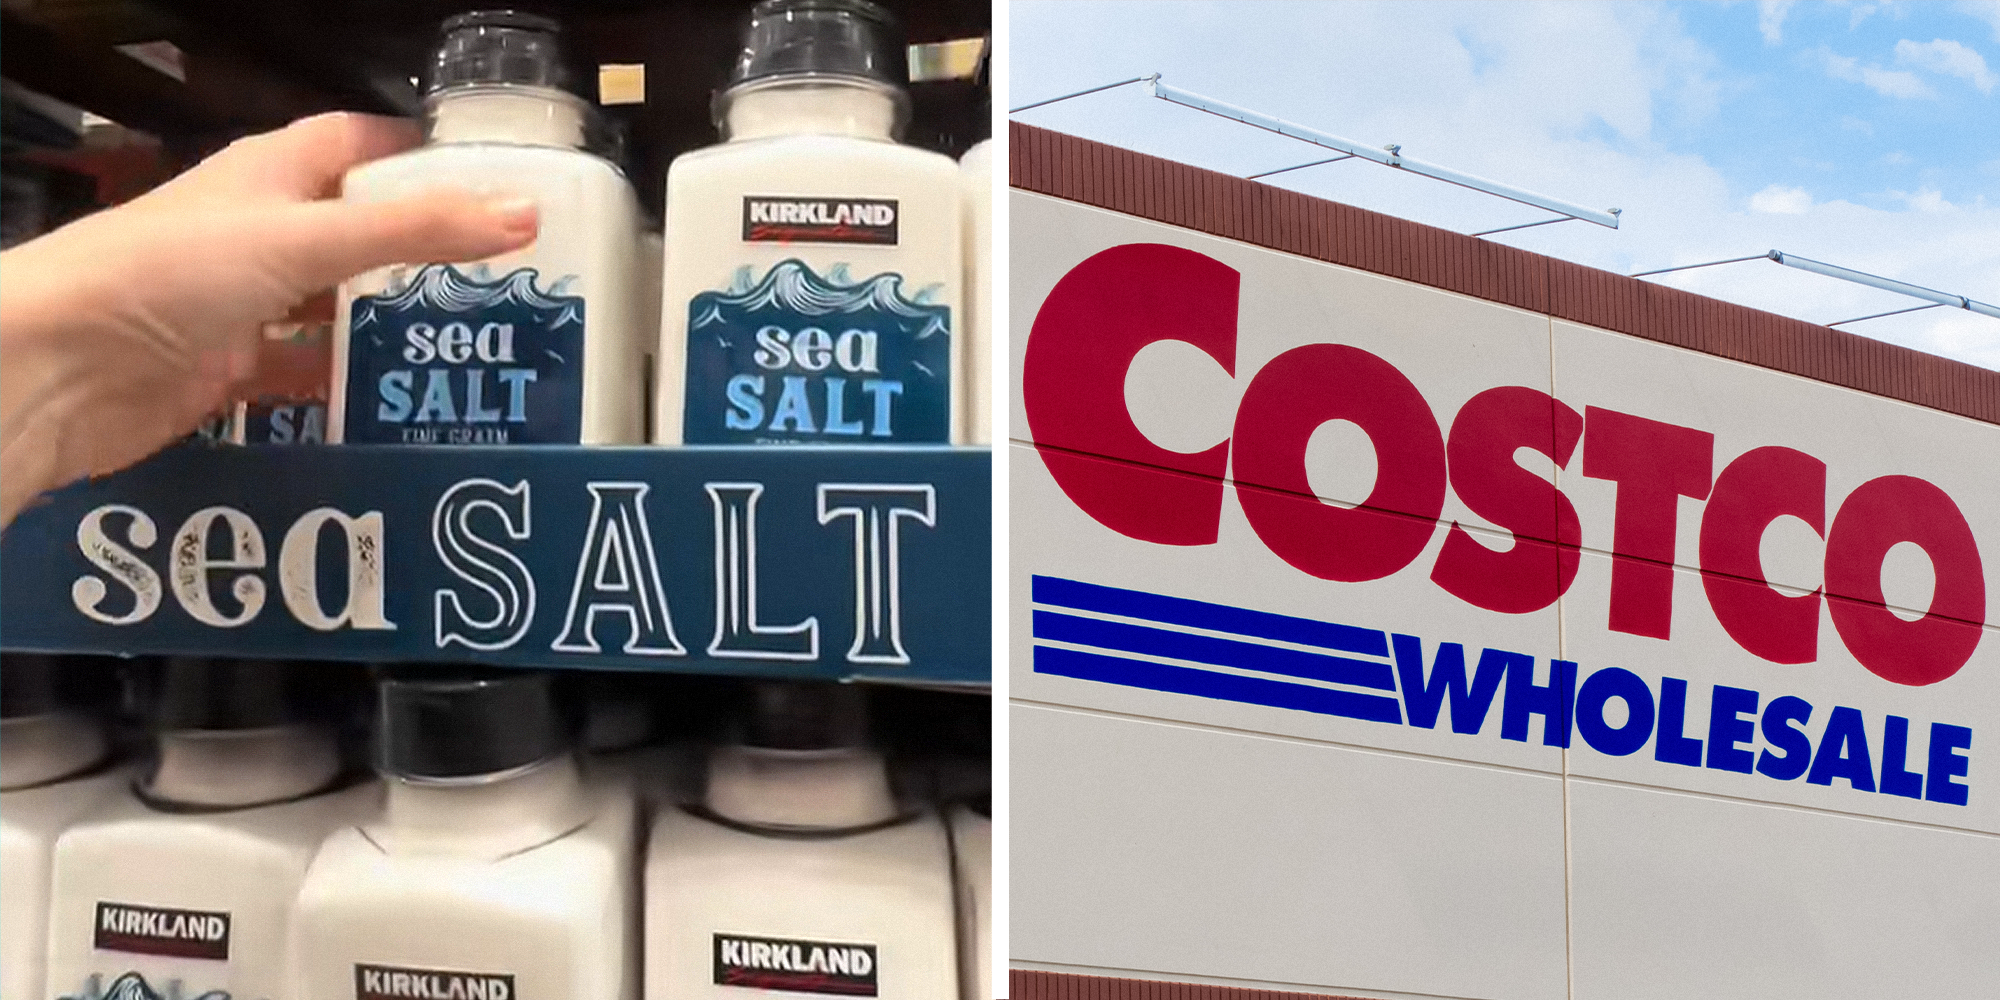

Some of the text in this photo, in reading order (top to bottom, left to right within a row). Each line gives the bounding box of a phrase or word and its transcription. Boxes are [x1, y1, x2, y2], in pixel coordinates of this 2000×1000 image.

[750, 202, 895, 226] KIRKLAND
[402, 321, 517, 365] sea
[753, 325, 879, 373] sea
[377, 368, 538, 422] SALT
[725, 373, 904, 437] SALT
[269, 405, 326, 446] SA
[1023, 243, 1986, 687] COSTCO
[71, 478, 937, 664] sea SALT
[1390, 633, 1973, 807] WHOLESALE
[102, 907, 226, 940] KIRKLAND
[720, 939, 873, 976] KIRKLAND
[363, 969, 509, 1000] KIRKLAND
